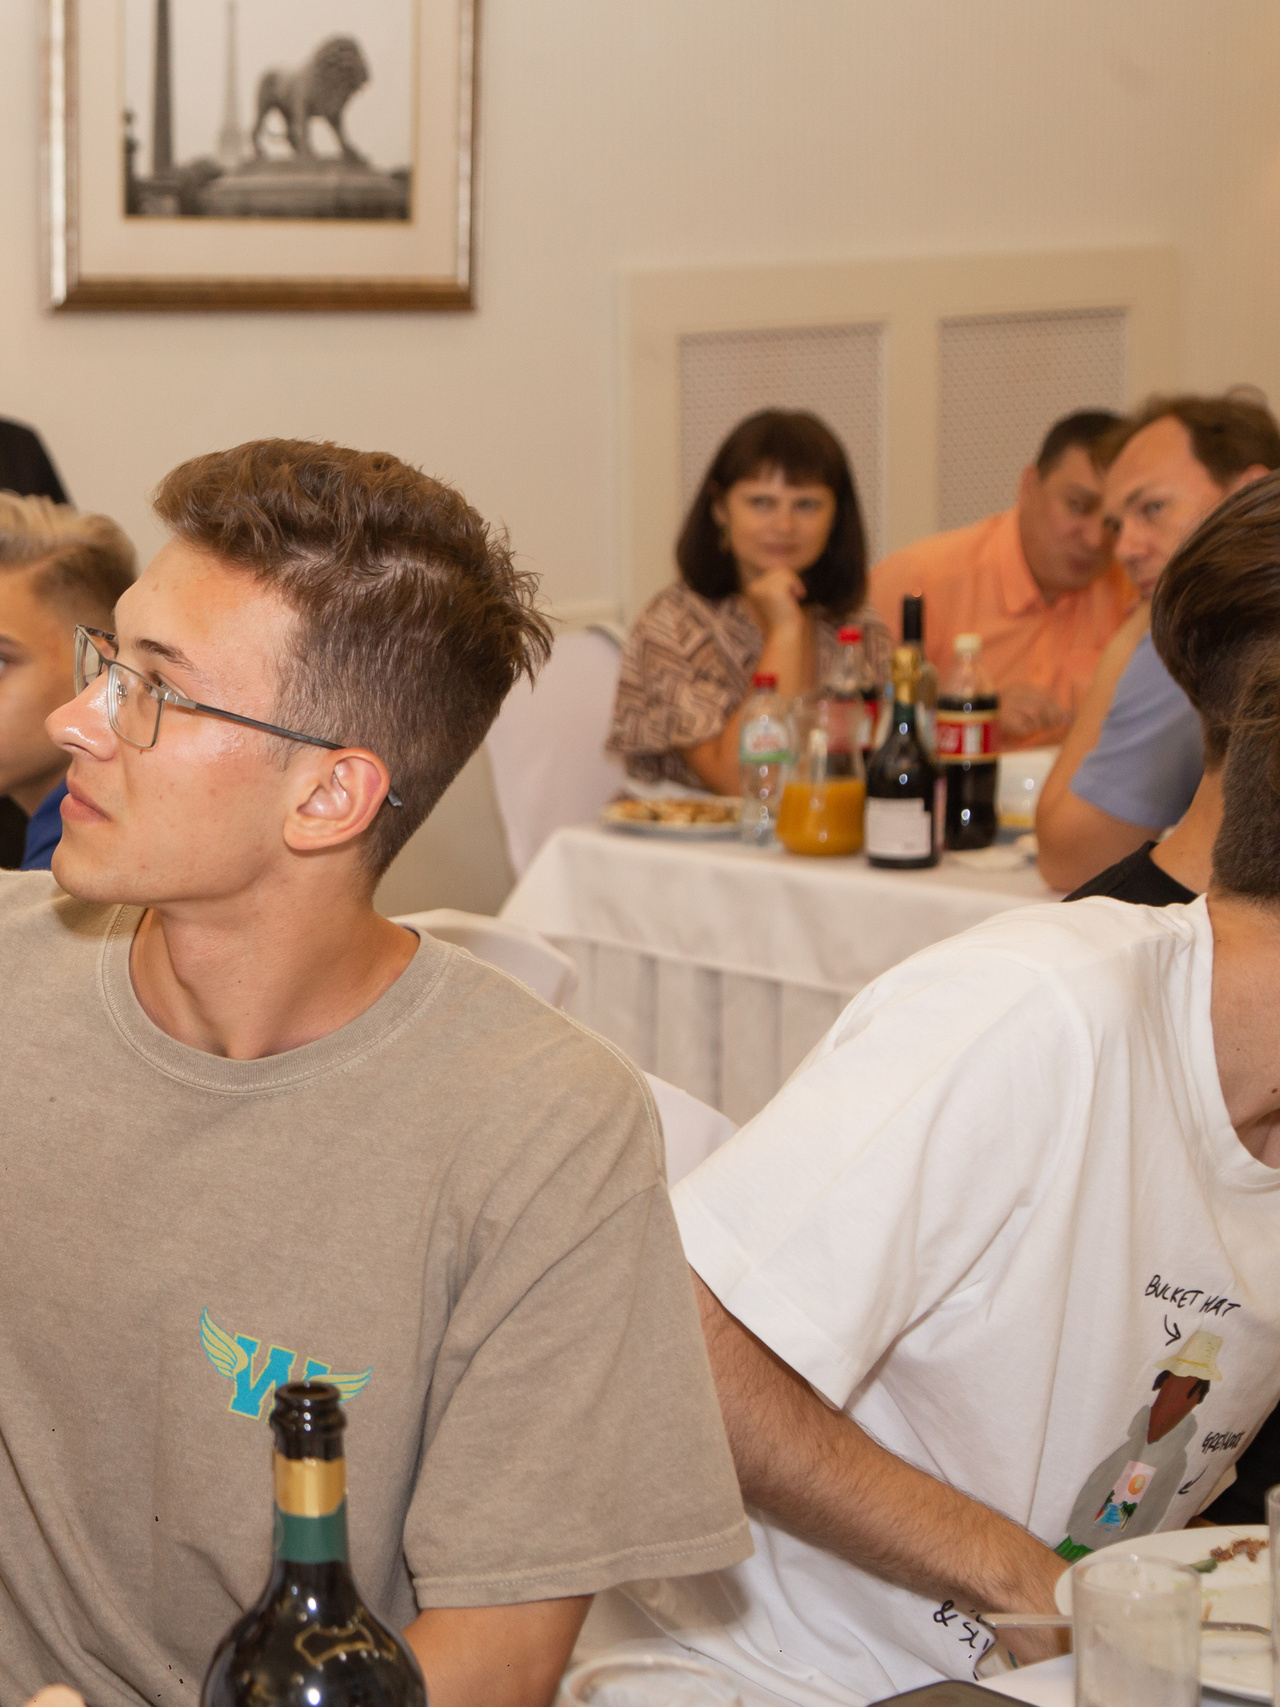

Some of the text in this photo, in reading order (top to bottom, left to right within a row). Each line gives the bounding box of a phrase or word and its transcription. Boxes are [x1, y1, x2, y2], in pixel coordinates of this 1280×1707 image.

[1144, 1274, 1241, 1317] BUCKET HAT
[932, 1599, 959, 1627] &
